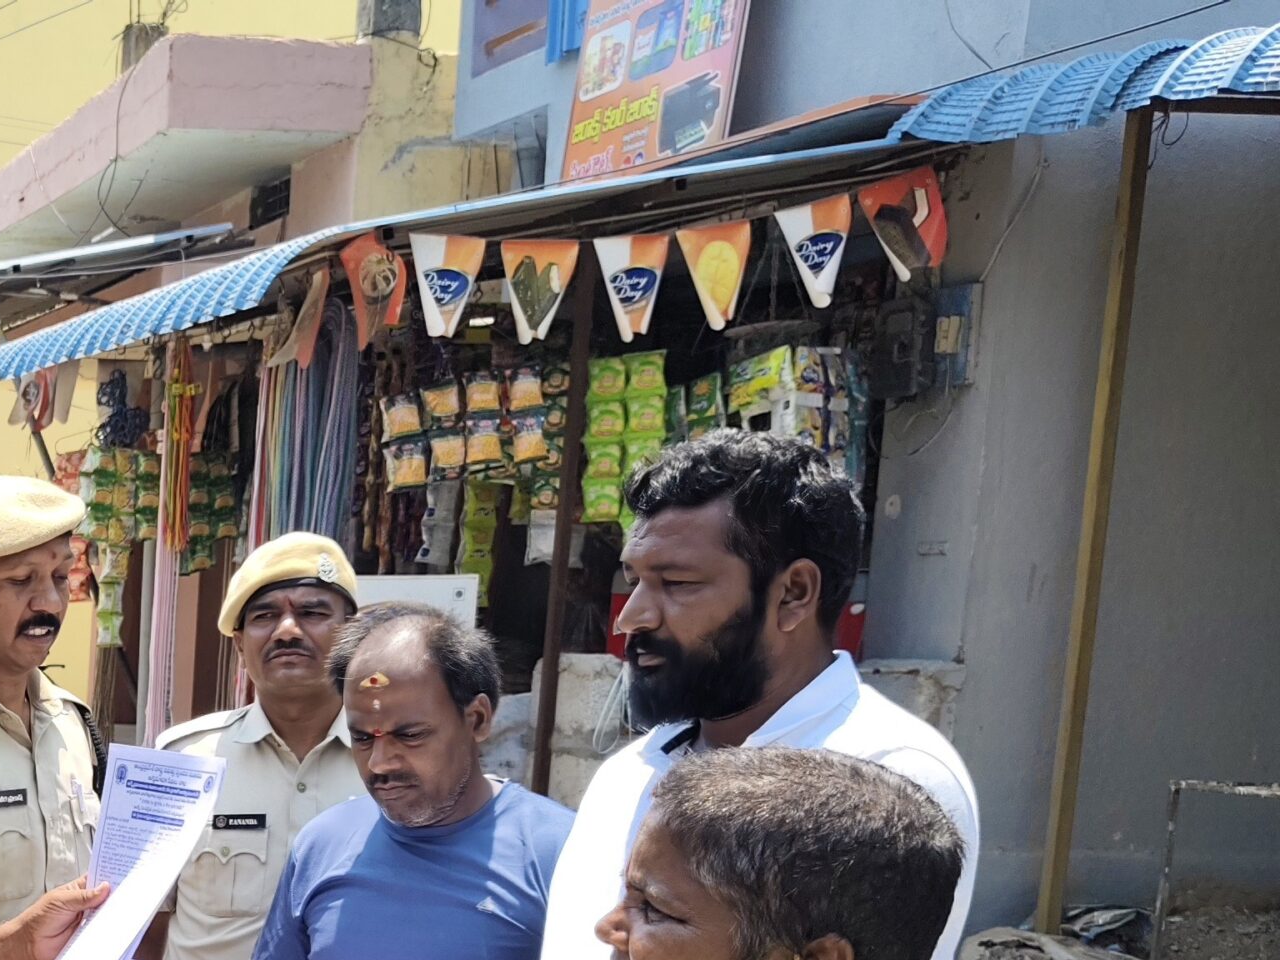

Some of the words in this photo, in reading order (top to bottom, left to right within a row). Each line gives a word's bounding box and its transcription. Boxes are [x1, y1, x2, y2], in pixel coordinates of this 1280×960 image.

[798, 241, 834, 255] Dairy
[805, 252, 830, 268] Day
[426, 272, 459, 292] Dairy
[613, 272, 648, 291] Dairy
[429, 286, 453, 304] Day
[617, 285, 644, 303] Day
